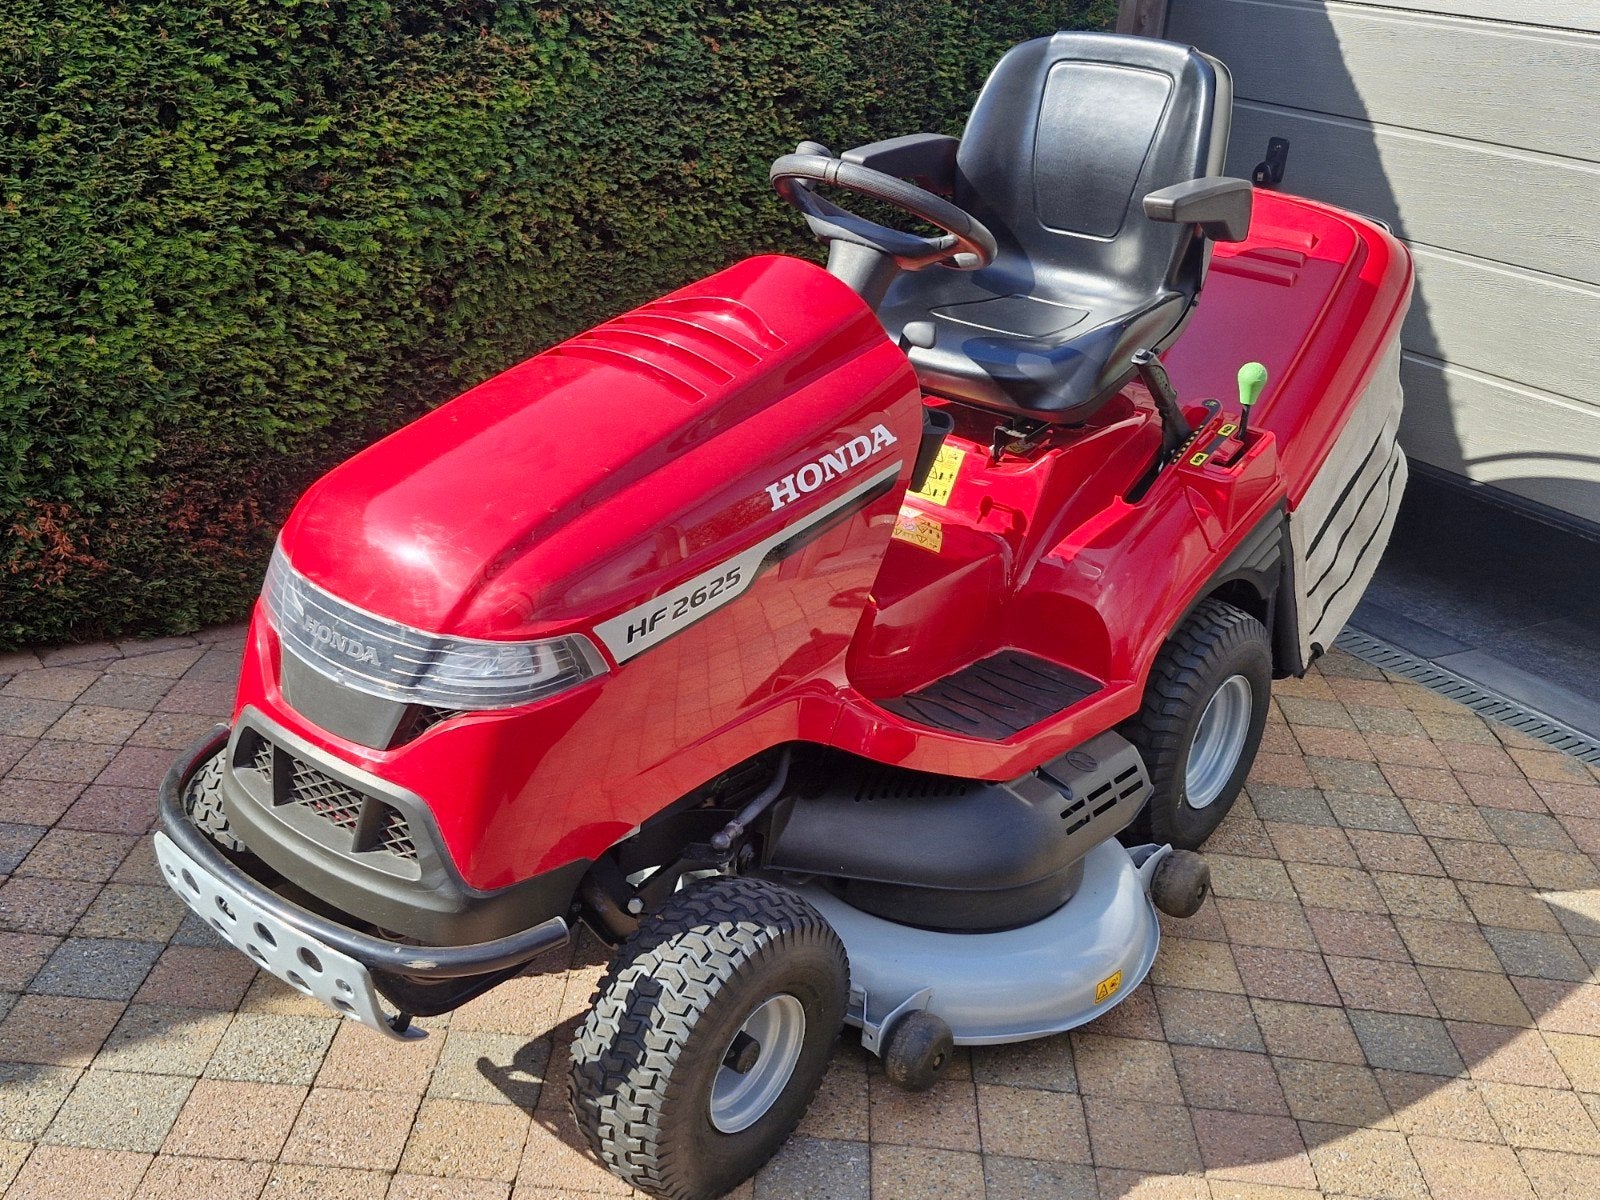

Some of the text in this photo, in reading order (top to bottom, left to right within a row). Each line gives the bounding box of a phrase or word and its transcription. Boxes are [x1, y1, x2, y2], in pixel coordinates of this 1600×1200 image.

[765, 423, 898, 512] HONDA
[302, 614, 382, 667] HONDA
[627, 566, 741, 644] HF 2625
